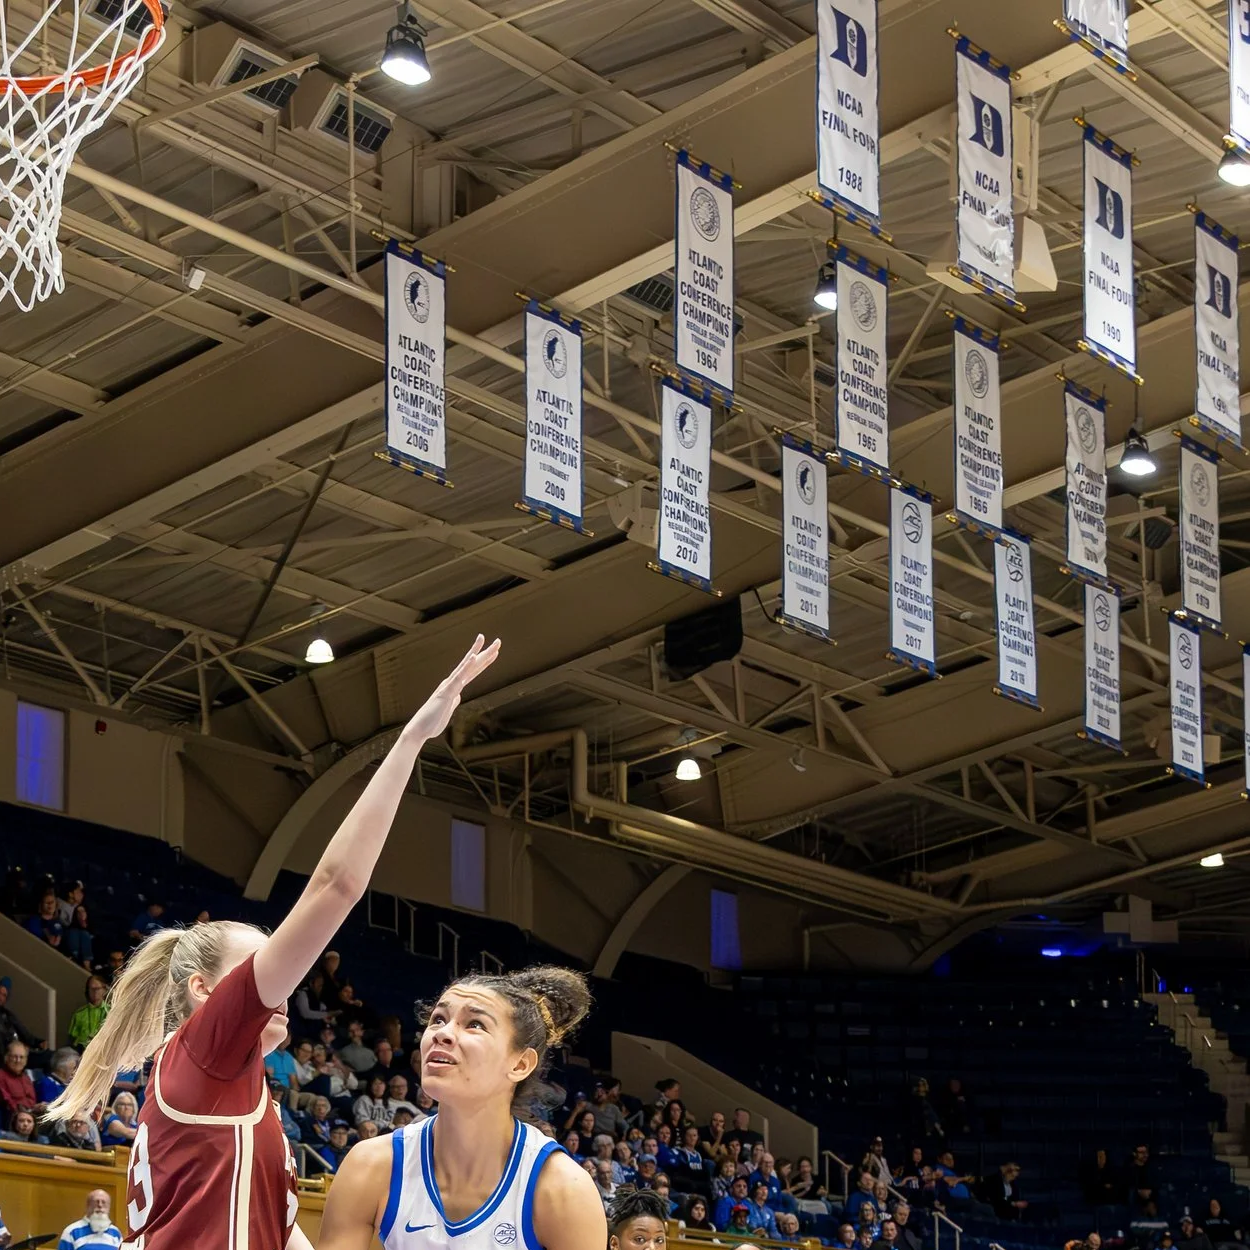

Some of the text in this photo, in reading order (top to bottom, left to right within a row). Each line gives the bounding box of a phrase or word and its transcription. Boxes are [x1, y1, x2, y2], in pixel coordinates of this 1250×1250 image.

[838, 89, 863, 118] NCAA
[822, 111, 850, 140] FINAL
[839, 167, 862, 193] 1988
[976, 171, 999, 196] NCAA
[689, 248, 723, 280] ATLANTIC
[1101, 251, 1120, 276] NCAA
[693, 270, 718, 294] COAST
[1088, 271, 1109, 295] FINAL
[681, 282, 731, 320] CONFERENCE
[683, 302, 729, 338] CHAMPIONS
[1103, 321, 1120, 342] 1990
[398, 334, 436, 363] ATLANTIC
[847, 339, 879, 366] ATLANTIC
[1211, 331, 1227, 352] NCAA
[404, 355, 431, 377] COAST
[696, 350, 717, 372] 1964
[853, 359, 875, 381] COAST
[1200, 351, 1221, 372] FINAL
[391, 366, 444, 402] CONFERENCE
[841, 370, 886, 403] CONFERENCE
[393, 386, 442, 418] CHAMPIONS
[536, 389, 573, 415] ATLANTIC
[843, 389, 885, 420] CHAMPIONS
[544, 408, 568, 429] COAST
[965, 406, 993, 430] ATLANTIC
[406, 431, 429, 452] 2006
[528, 420, 579, 453] CONFERENCE
[858, 432, 876, 452] 1965
[968, 424, 989, 443] COAST
[530, 439, 577, 469] CHAMPIONS
[959, 435, 1001, 465] CONFERENCE
[961, 453, 1000, 482] CHAMPIONS
[545, 481, 565, 501] 2009
[1079, 480, 1102, 499] COAST
[970, 495, 987, 513] 1966
[792, 515, 821, 537] ATLANTIC
[797, 533, 817, 551] COAST
[676, 546, 698, 564] 2010
[786, 544, 829, 572] CONFERENCE
[901, 555, 928, 576] ATLANTIC
[789, 560, 827, 586] CHAMPIONS
[904, 572, 922, 589] COAST
[800, 599, 817, 616] 2011
[897, 598, 932, 622] CHAMPIONS
[906, 634, 921, 650] 2017
